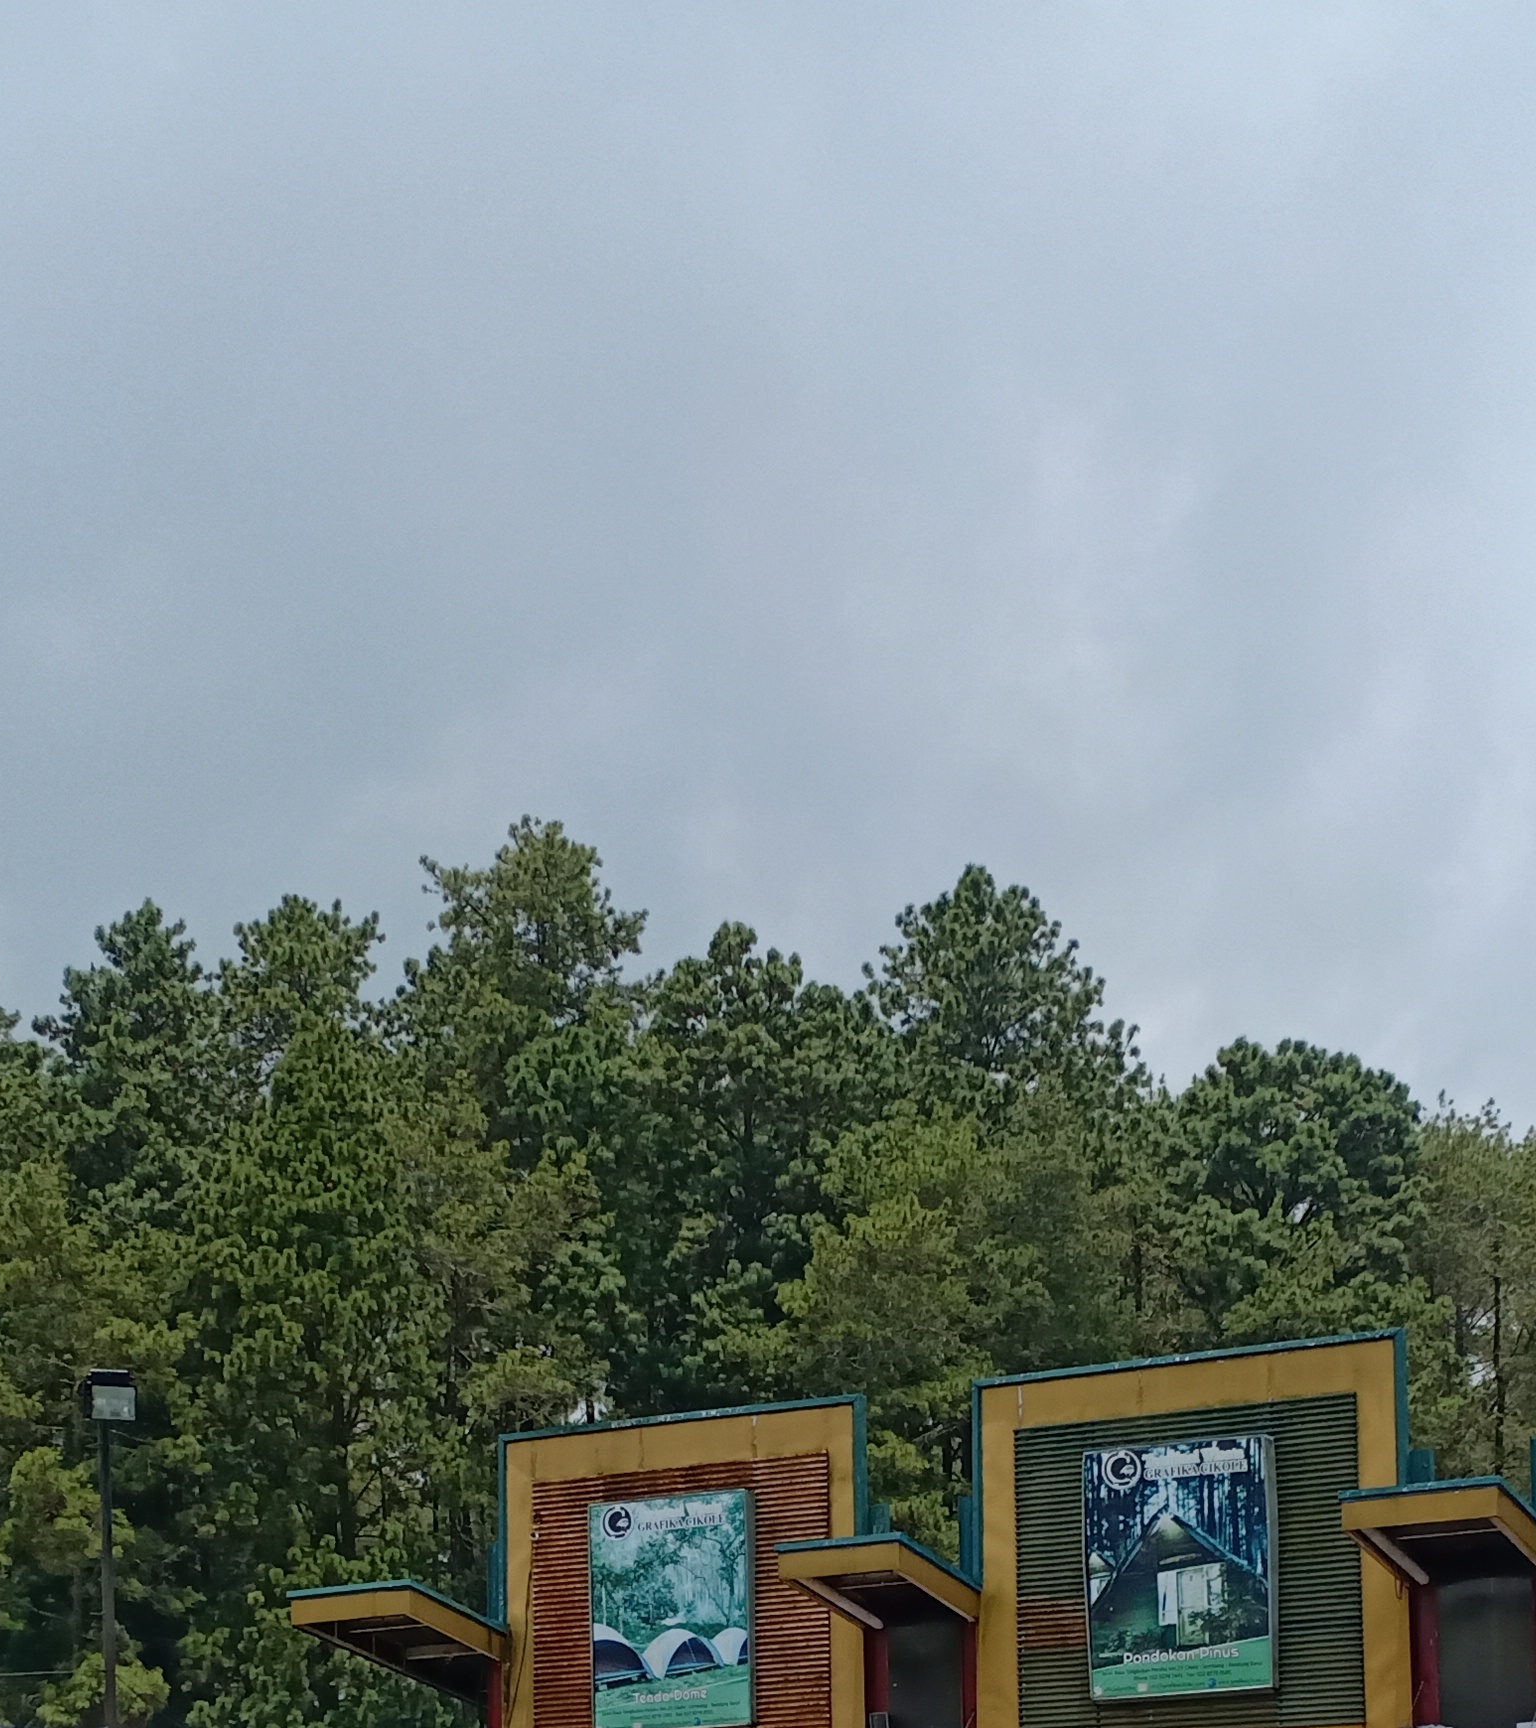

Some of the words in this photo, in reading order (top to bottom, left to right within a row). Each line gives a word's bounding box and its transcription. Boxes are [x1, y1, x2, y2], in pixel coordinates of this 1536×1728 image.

[1123, 1649, 1195, 1665] Pondokan
[1199, 1646, 1240, 1659] Pinus
[673, 1688, 708, 1702] Dome
